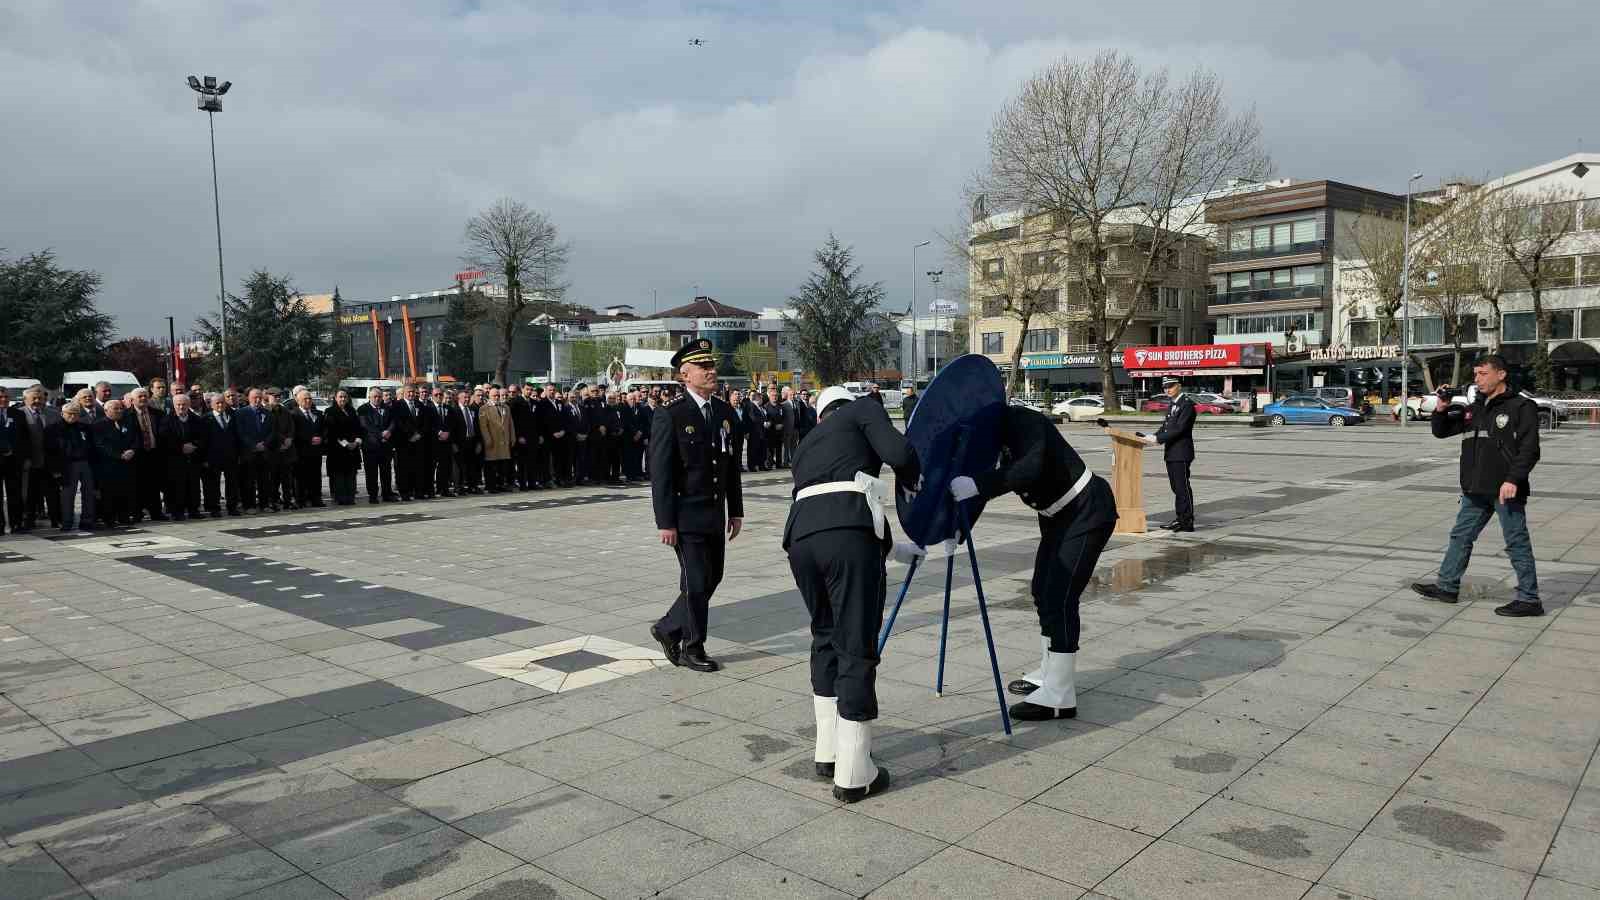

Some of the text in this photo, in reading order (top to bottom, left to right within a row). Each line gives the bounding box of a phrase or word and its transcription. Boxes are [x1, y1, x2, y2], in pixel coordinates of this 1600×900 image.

[1147, 351, 1162, 360] SUN
[1164, 350, 1204, 360] BROTHERS
[1310, 345, 1399, 360] CAJUN CORNER
